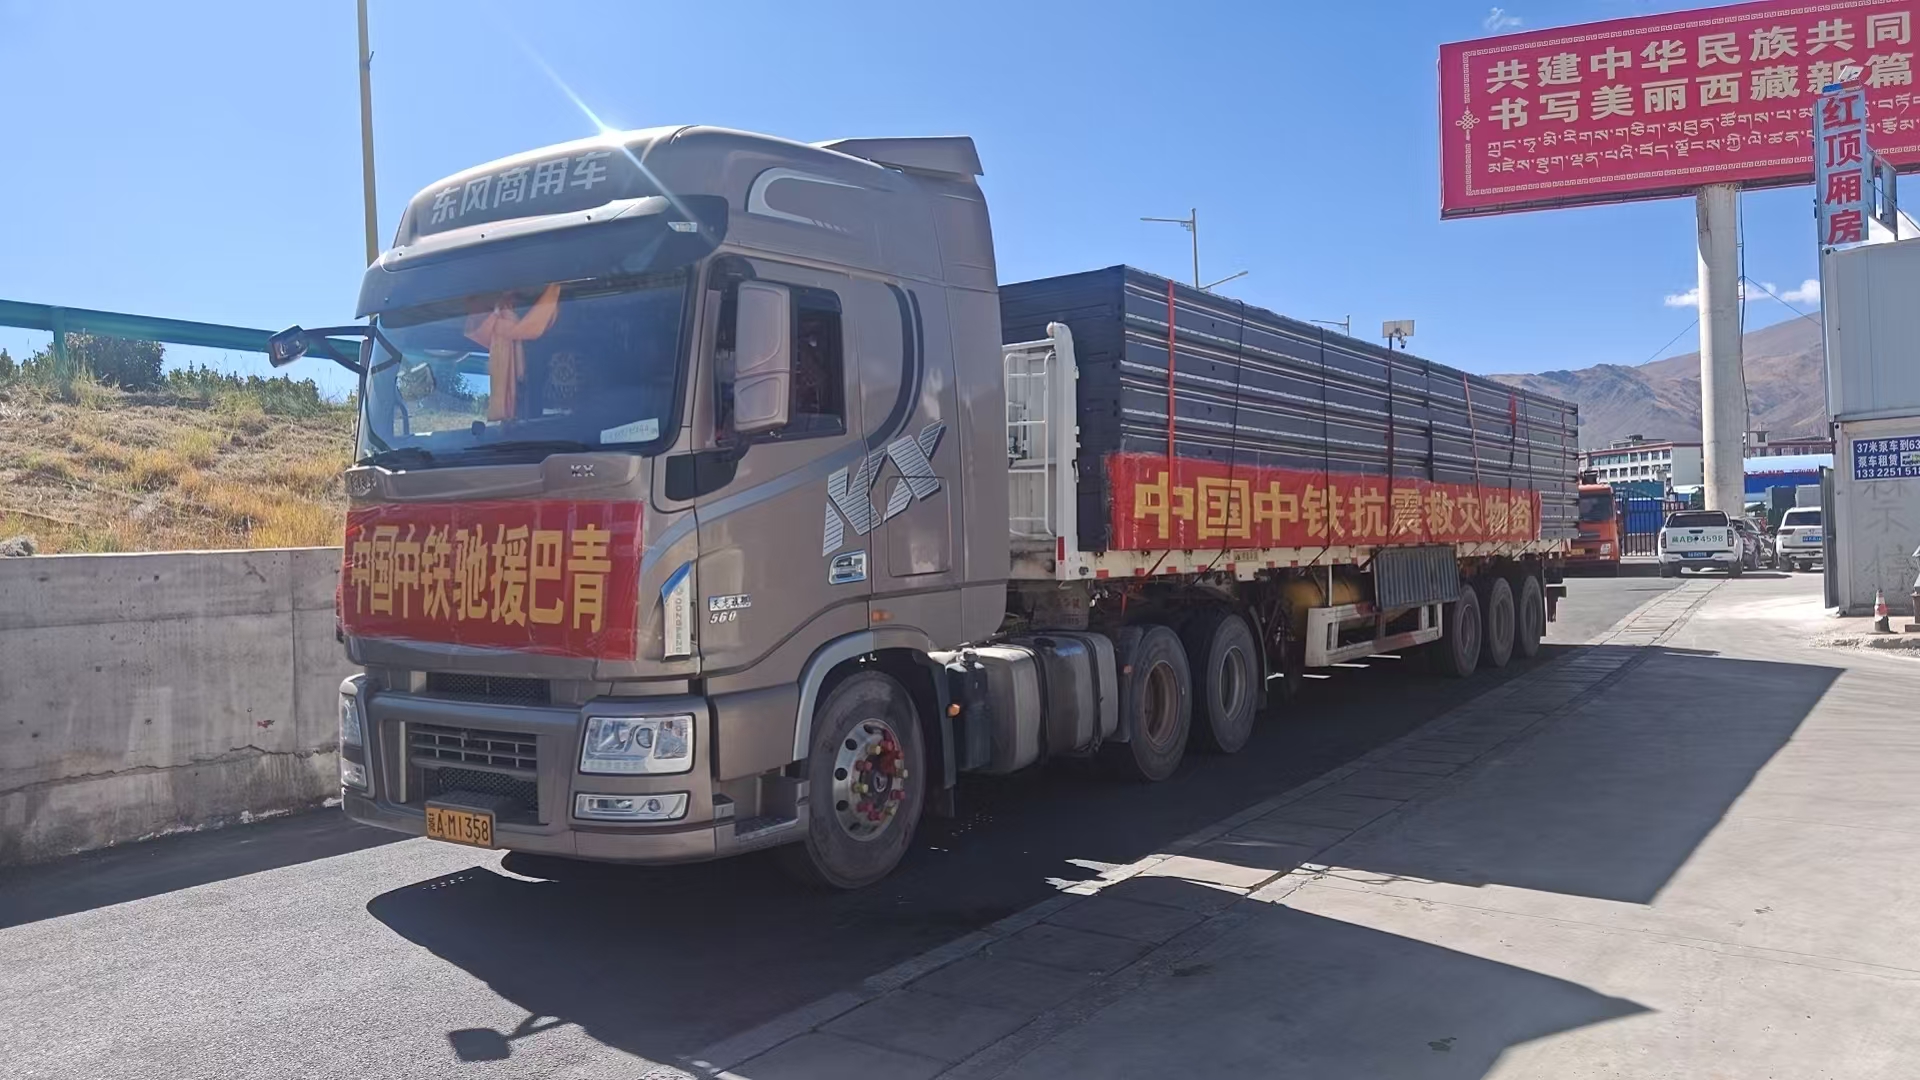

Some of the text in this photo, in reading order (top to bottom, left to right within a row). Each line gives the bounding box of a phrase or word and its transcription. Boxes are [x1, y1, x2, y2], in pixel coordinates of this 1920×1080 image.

[1486, 11, 1912, 94] 共建中华民族共同
[1487, 52, 1914, 130] 书写美丽西藏新篇
[431, 152, 611, 225] 东风商用车
[1822, 95, 1863, 245] 红顶厢房
[571, 464, 596, 478] KX
[1856, 438, 1920, 453] 37米泵车到63
[1856, 469, 1875, 478] 133
[1876, 467, 1902, 477] 2251
[1857, 454, 1898, 468] 泵车租赁
[1134, 472, 1532, 541] 中国中铁抗震救灾物资
[351, 523, 611, 633] 中国中铁驰援巴青
[709, 611, 737, 624] 560
